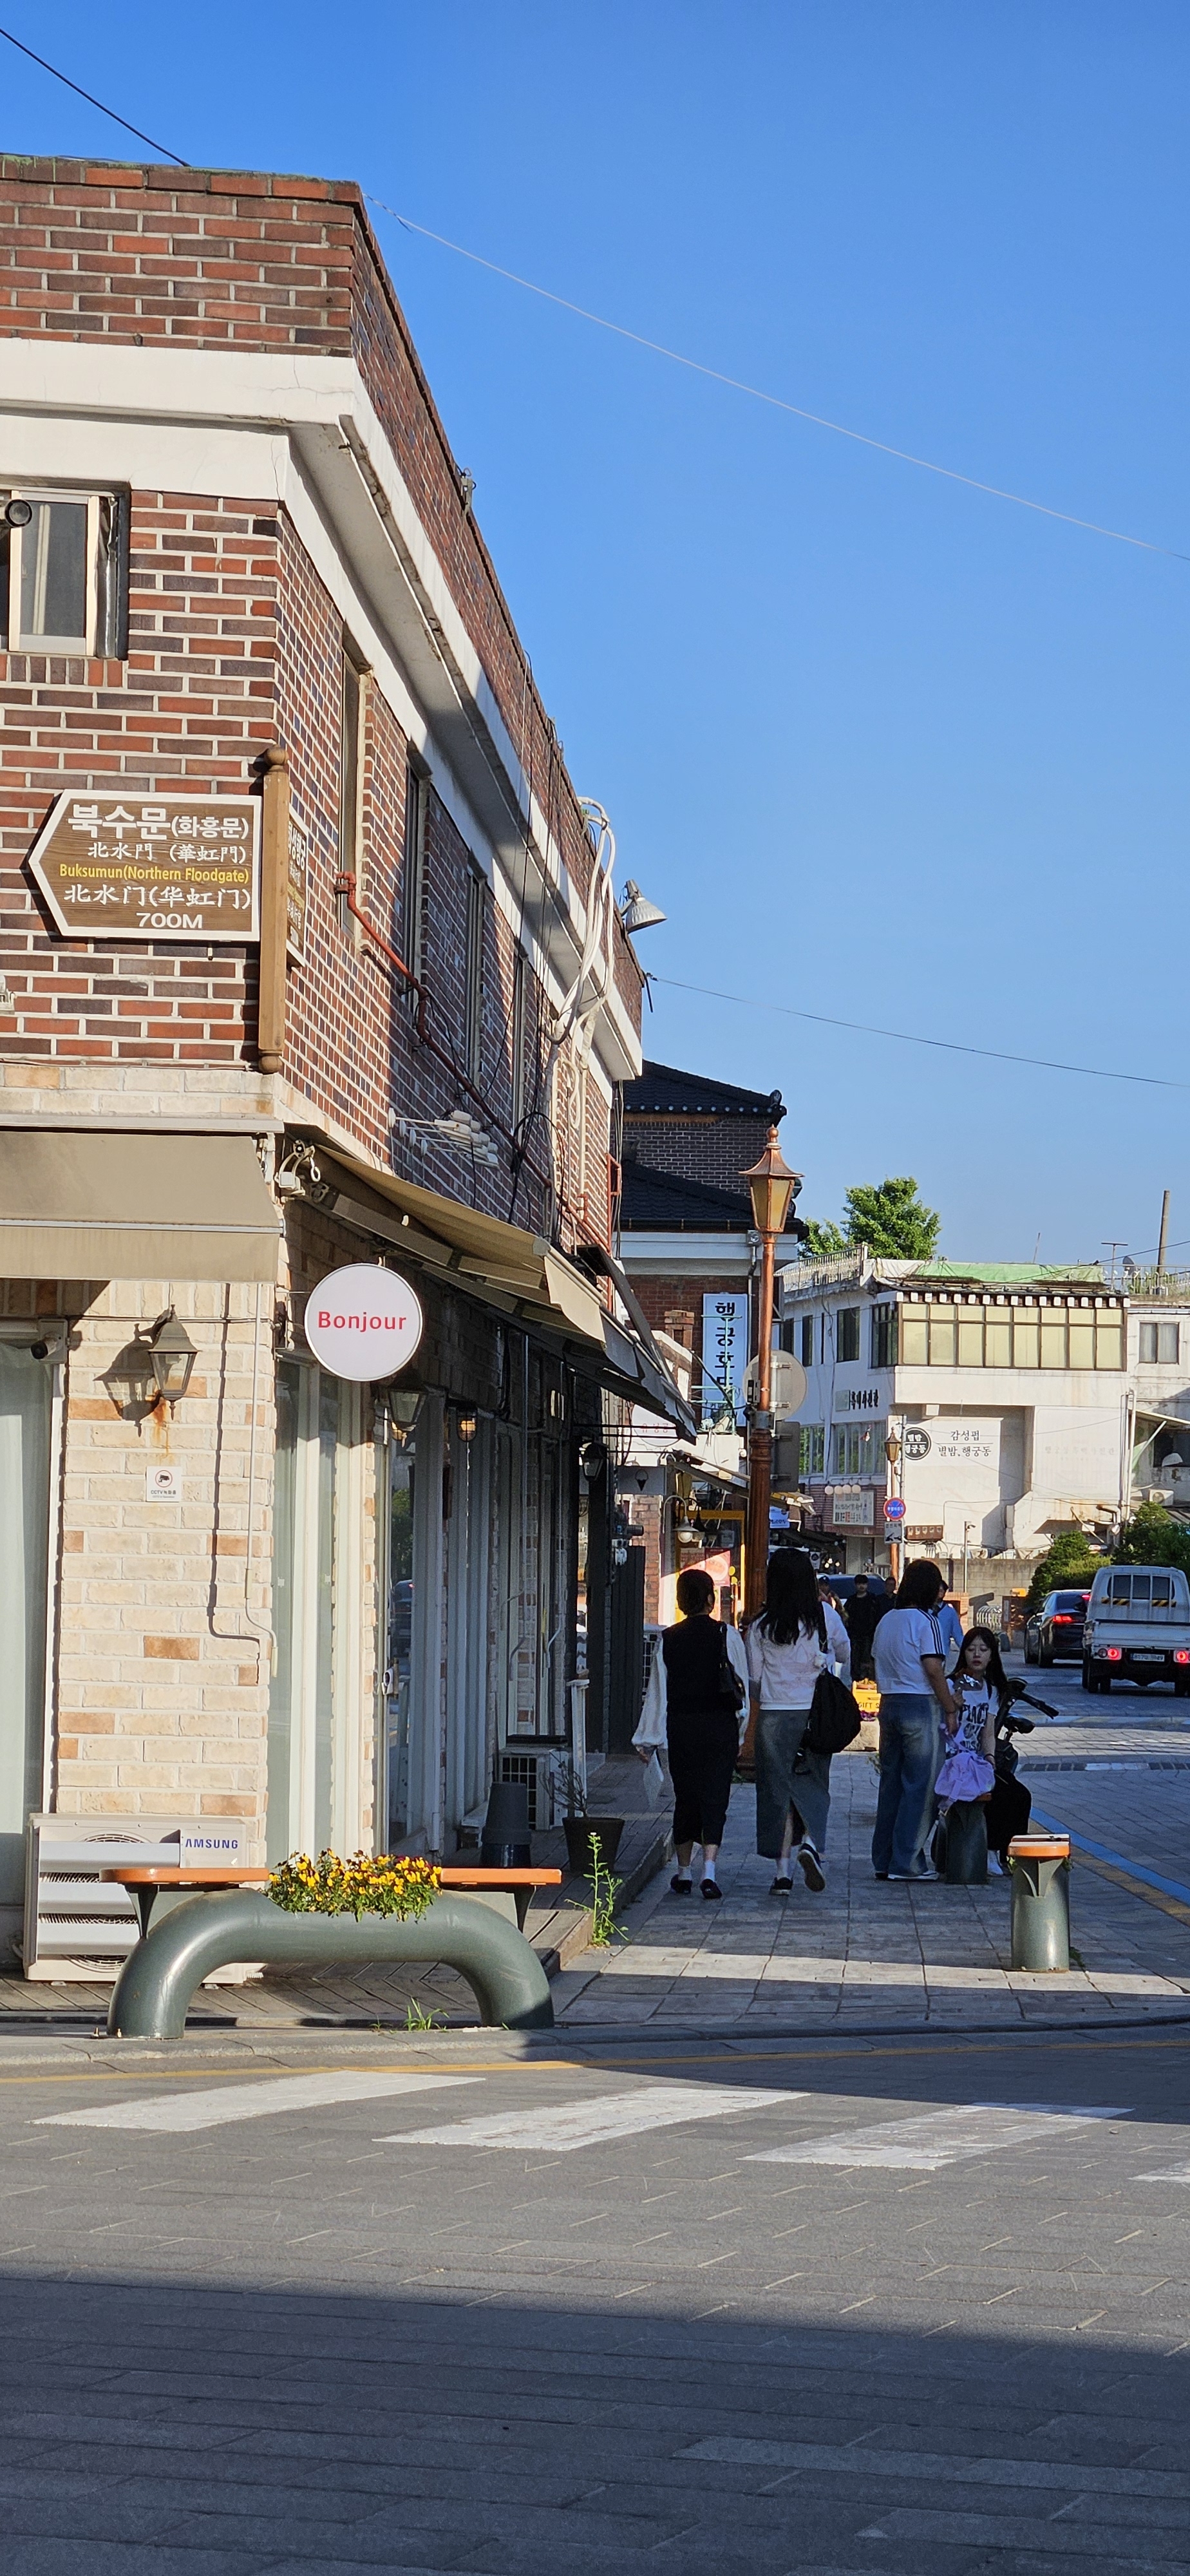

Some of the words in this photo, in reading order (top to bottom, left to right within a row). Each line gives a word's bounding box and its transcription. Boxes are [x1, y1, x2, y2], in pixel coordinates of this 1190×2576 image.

[68, 804, 249, 840] 북수문(화홍문)
[88, 842, 153, 861] 北水門
[169, 844, 247, 864] (華虹門)
[60, 864, 181, 881] Buksumun(Northern
[185, 866, 249, 884] Floodgate)
[64, 884, 252, 910] 北水门(华虹门)
[136, 912, 203, 929] 700M
[318, 1311, 406, 1332] Bonjour
[950, 1430, 979, 1441] 감성펍
[185, 1839, 238, 1850] AMSUNG
